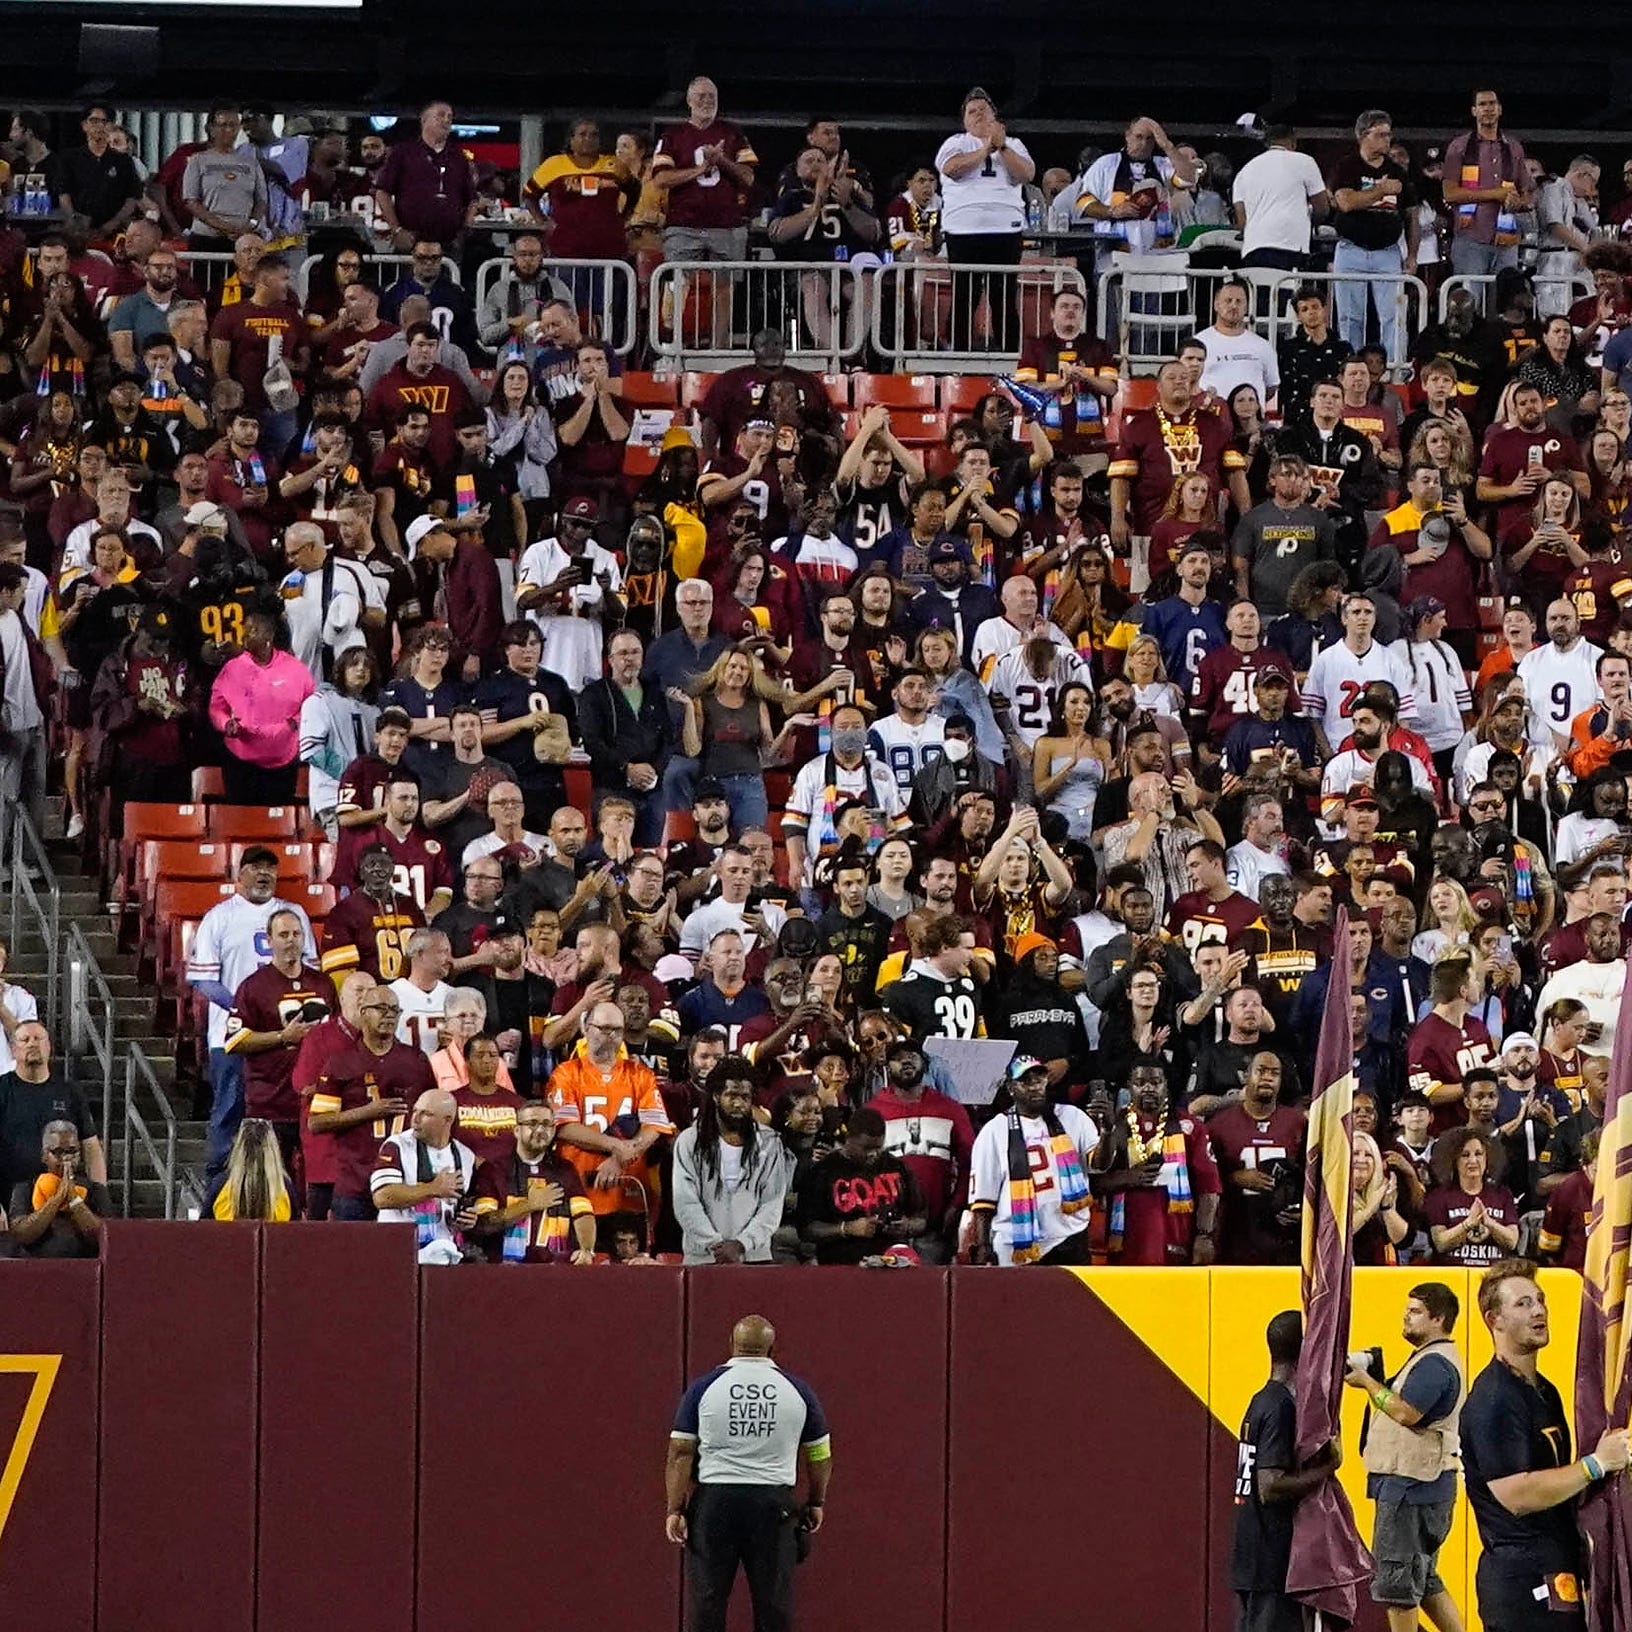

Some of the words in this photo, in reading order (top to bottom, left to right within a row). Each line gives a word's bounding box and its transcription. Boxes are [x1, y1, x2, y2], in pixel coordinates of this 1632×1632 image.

[855, 503, 892, 547] 54
[201, 602, 244, 646] 93
[1185, 628, 1207, 673] 6
[1015, 685, 1060, 729] 21
[1550, 682, 1571, 722] 9
[933, 996, 976, 1038] 39
[458, 1106, 516, 1119] COMMANDERS
[833, 1173, 901, 1211] GOAT
[729, 1384, 777, 1400] CSC
[729, 1402, 777, 1419] EVENT
[728, 1421, 777, 1437] STAFF
